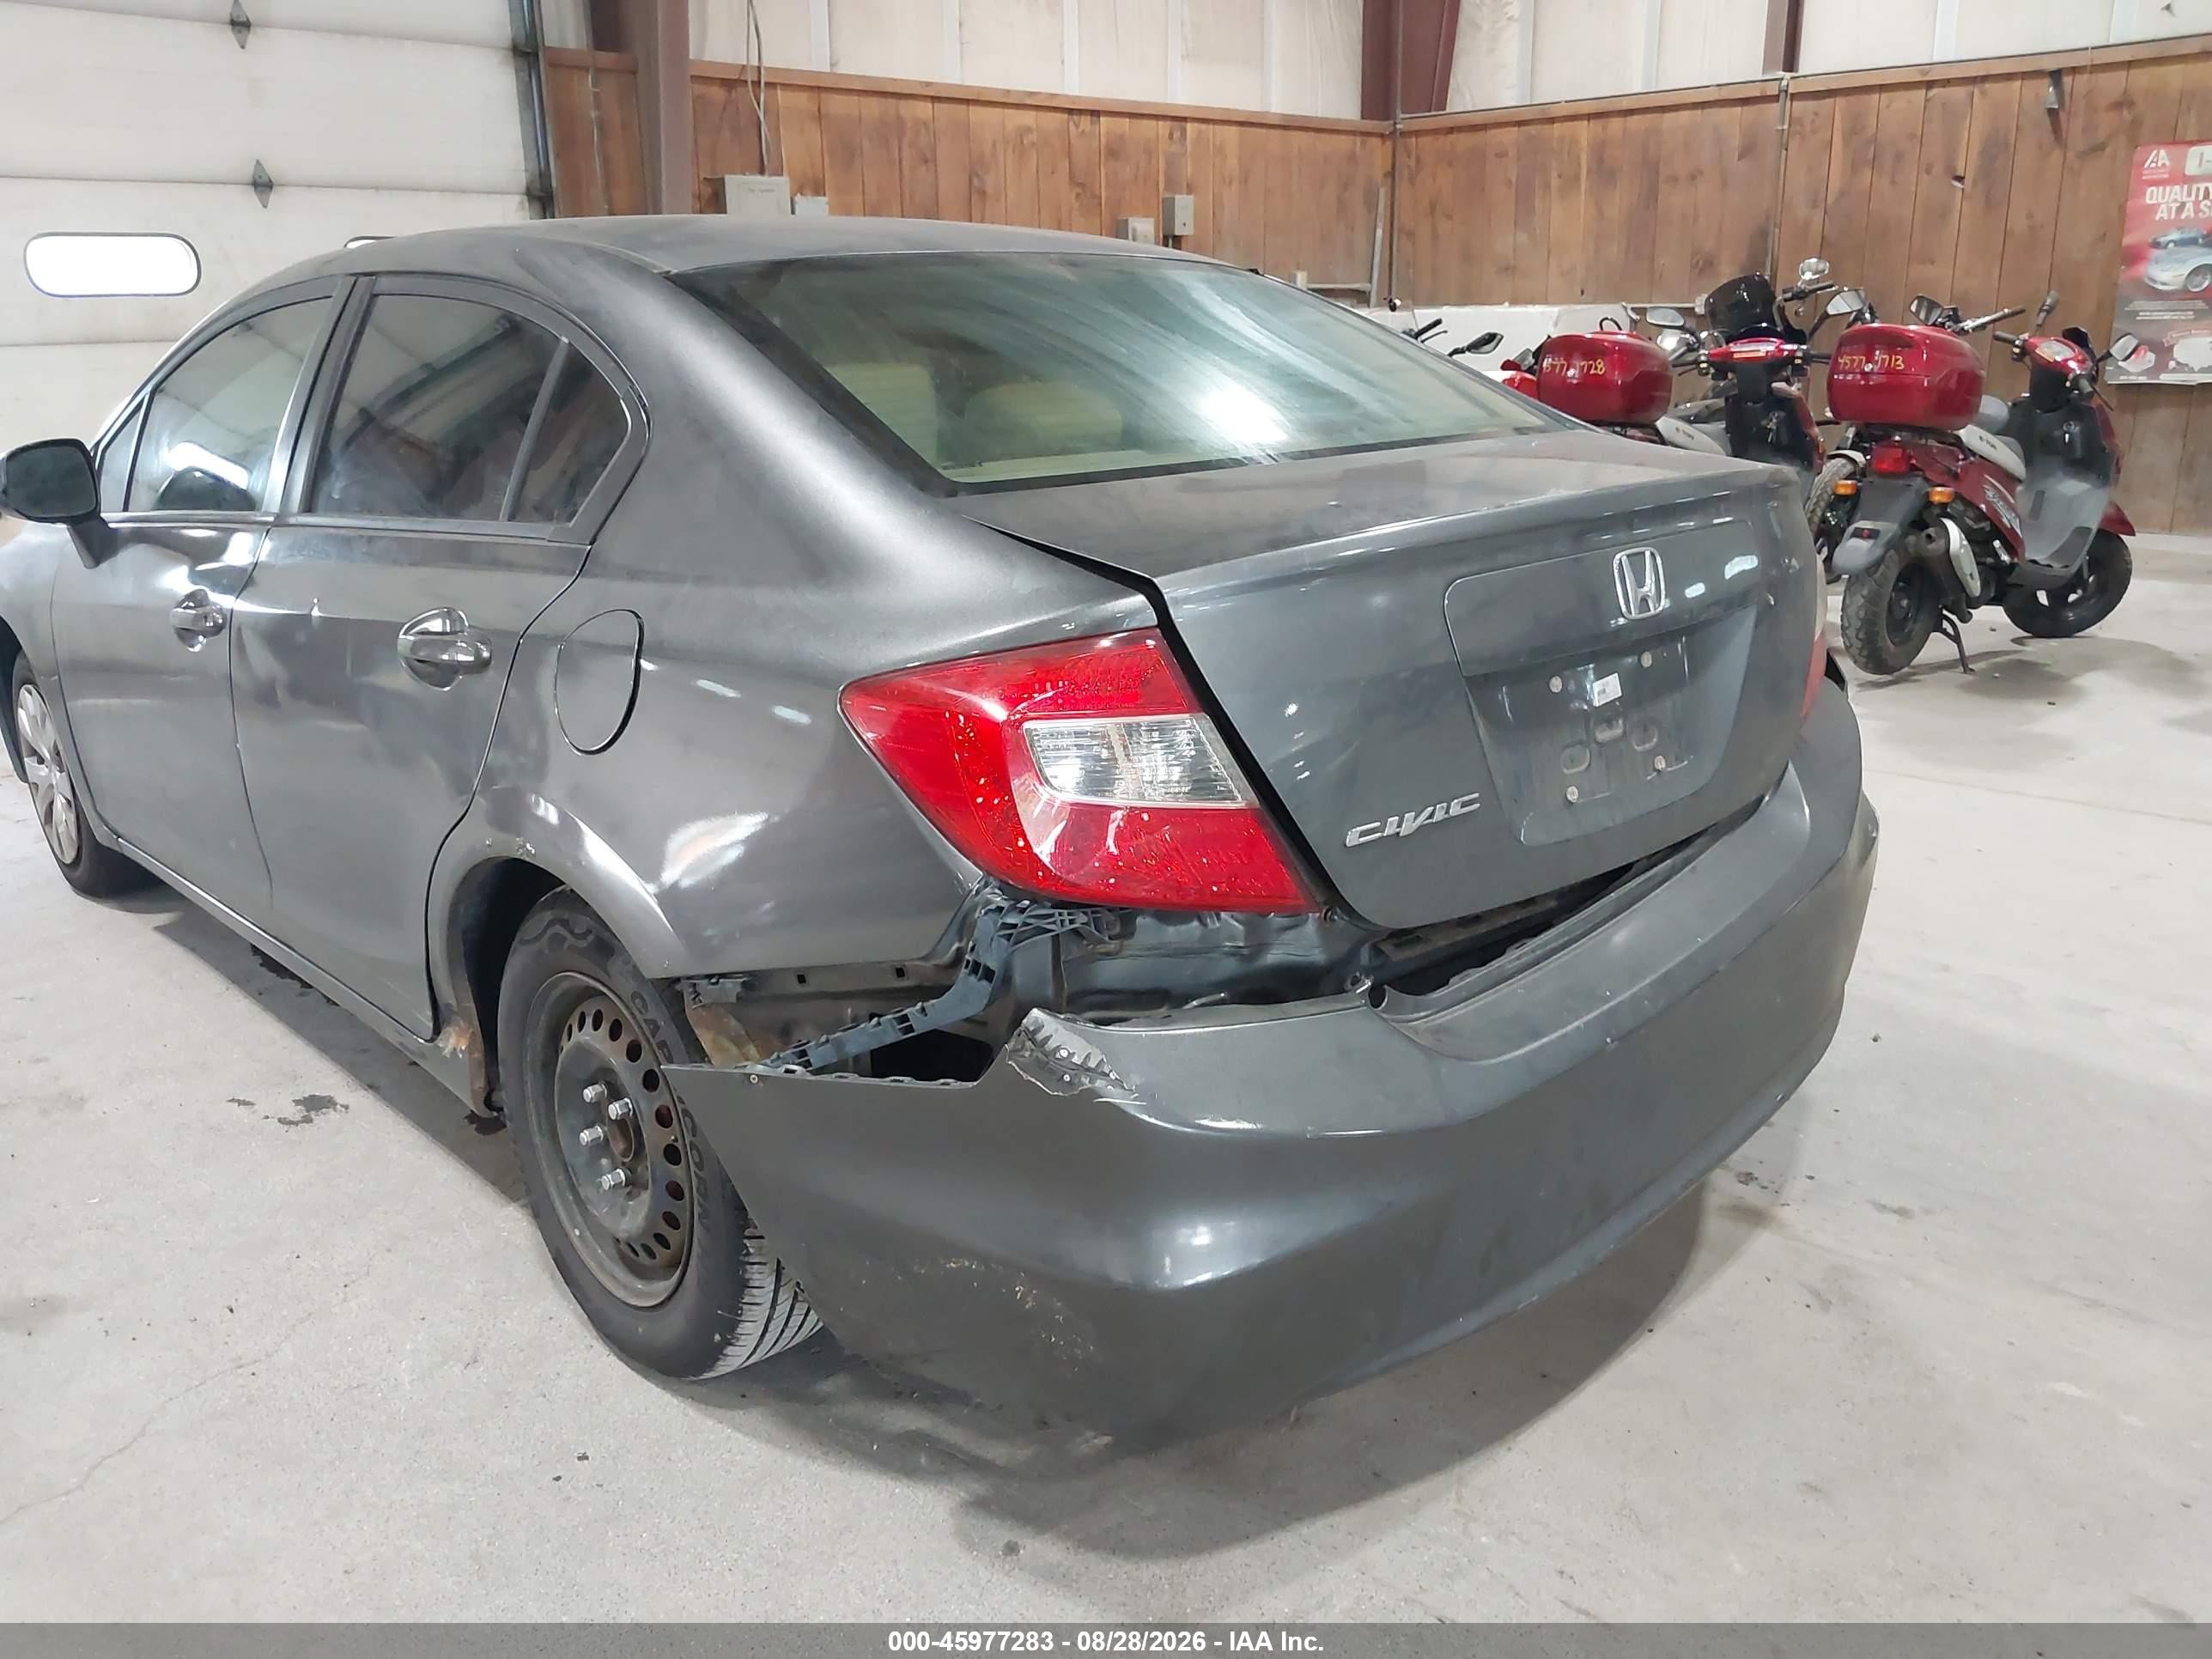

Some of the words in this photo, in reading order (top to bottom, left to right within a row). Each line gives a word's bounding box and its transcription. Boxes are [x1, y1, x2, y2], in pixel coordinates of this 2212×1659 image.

[2155, 203, 2181, 221] AT
[2181, 201, 2195, 220] A
[2199, 199, 2212, 218] S
[1838, 354, 1866, 370] 4577
[1346, 793, 1480, 848] CIVIC
